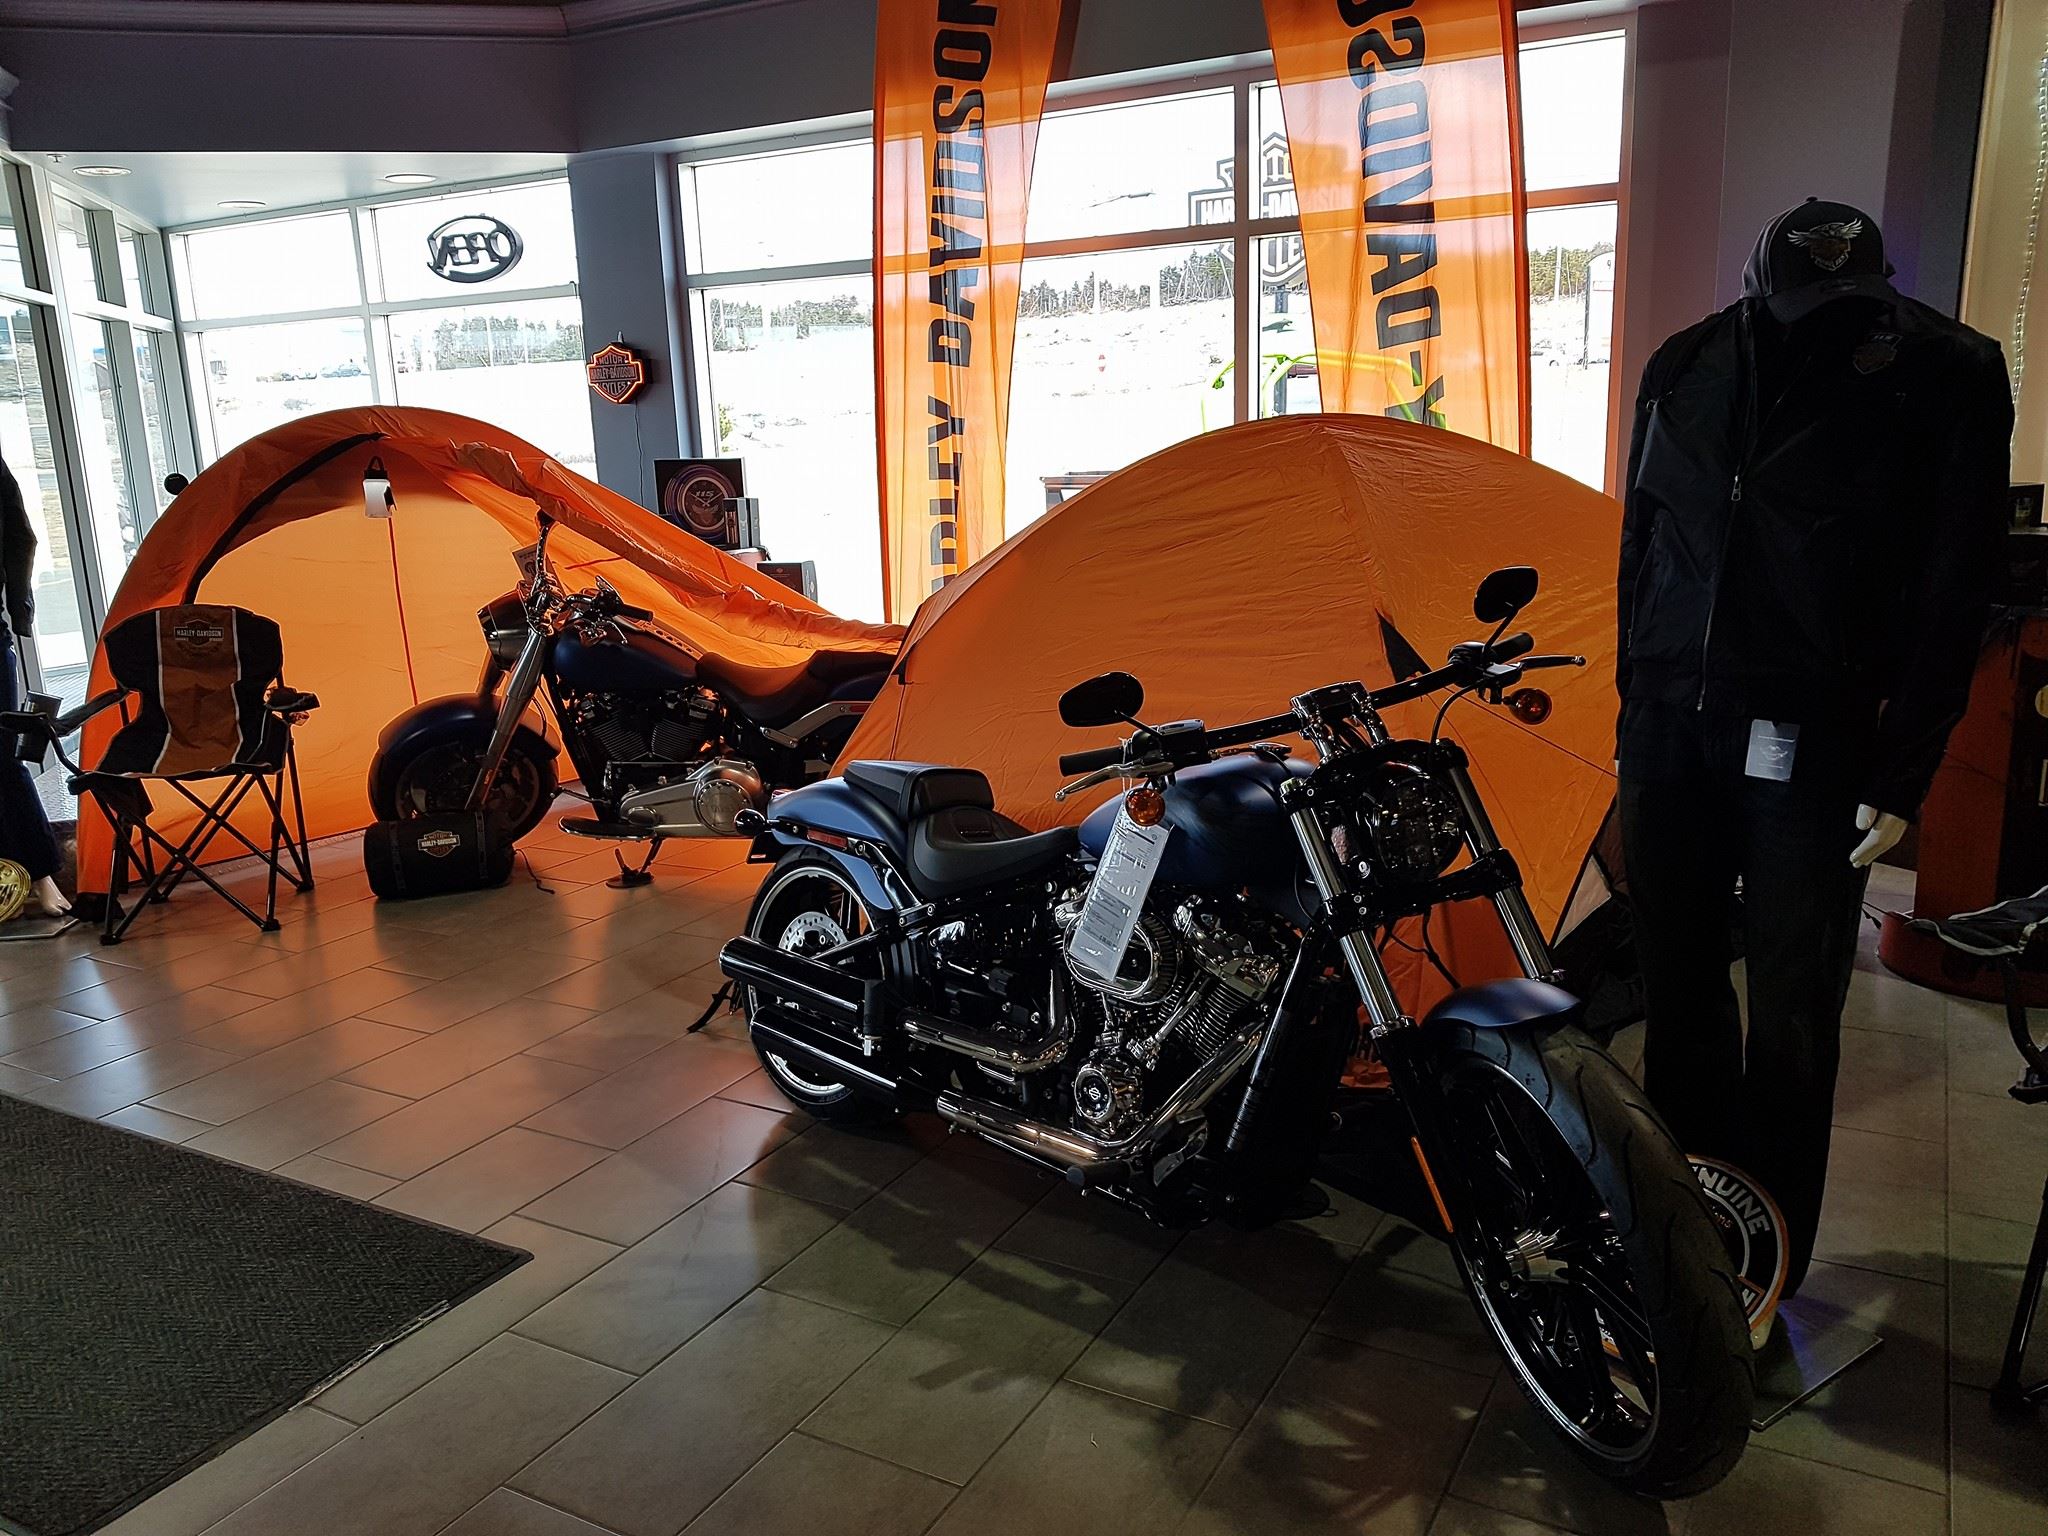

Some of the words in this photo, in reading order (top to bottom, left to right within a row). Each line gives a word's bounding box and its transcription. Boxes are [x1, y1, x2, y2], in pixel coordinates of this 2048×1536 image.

[599, 354, 623, 365] MOTOR
[590, 367, 635, 379] HARLEY-DAVIDSON
[602, 381, 626, 395] CYCLES
[1693, 1166, 1770, 1235] NUINE
